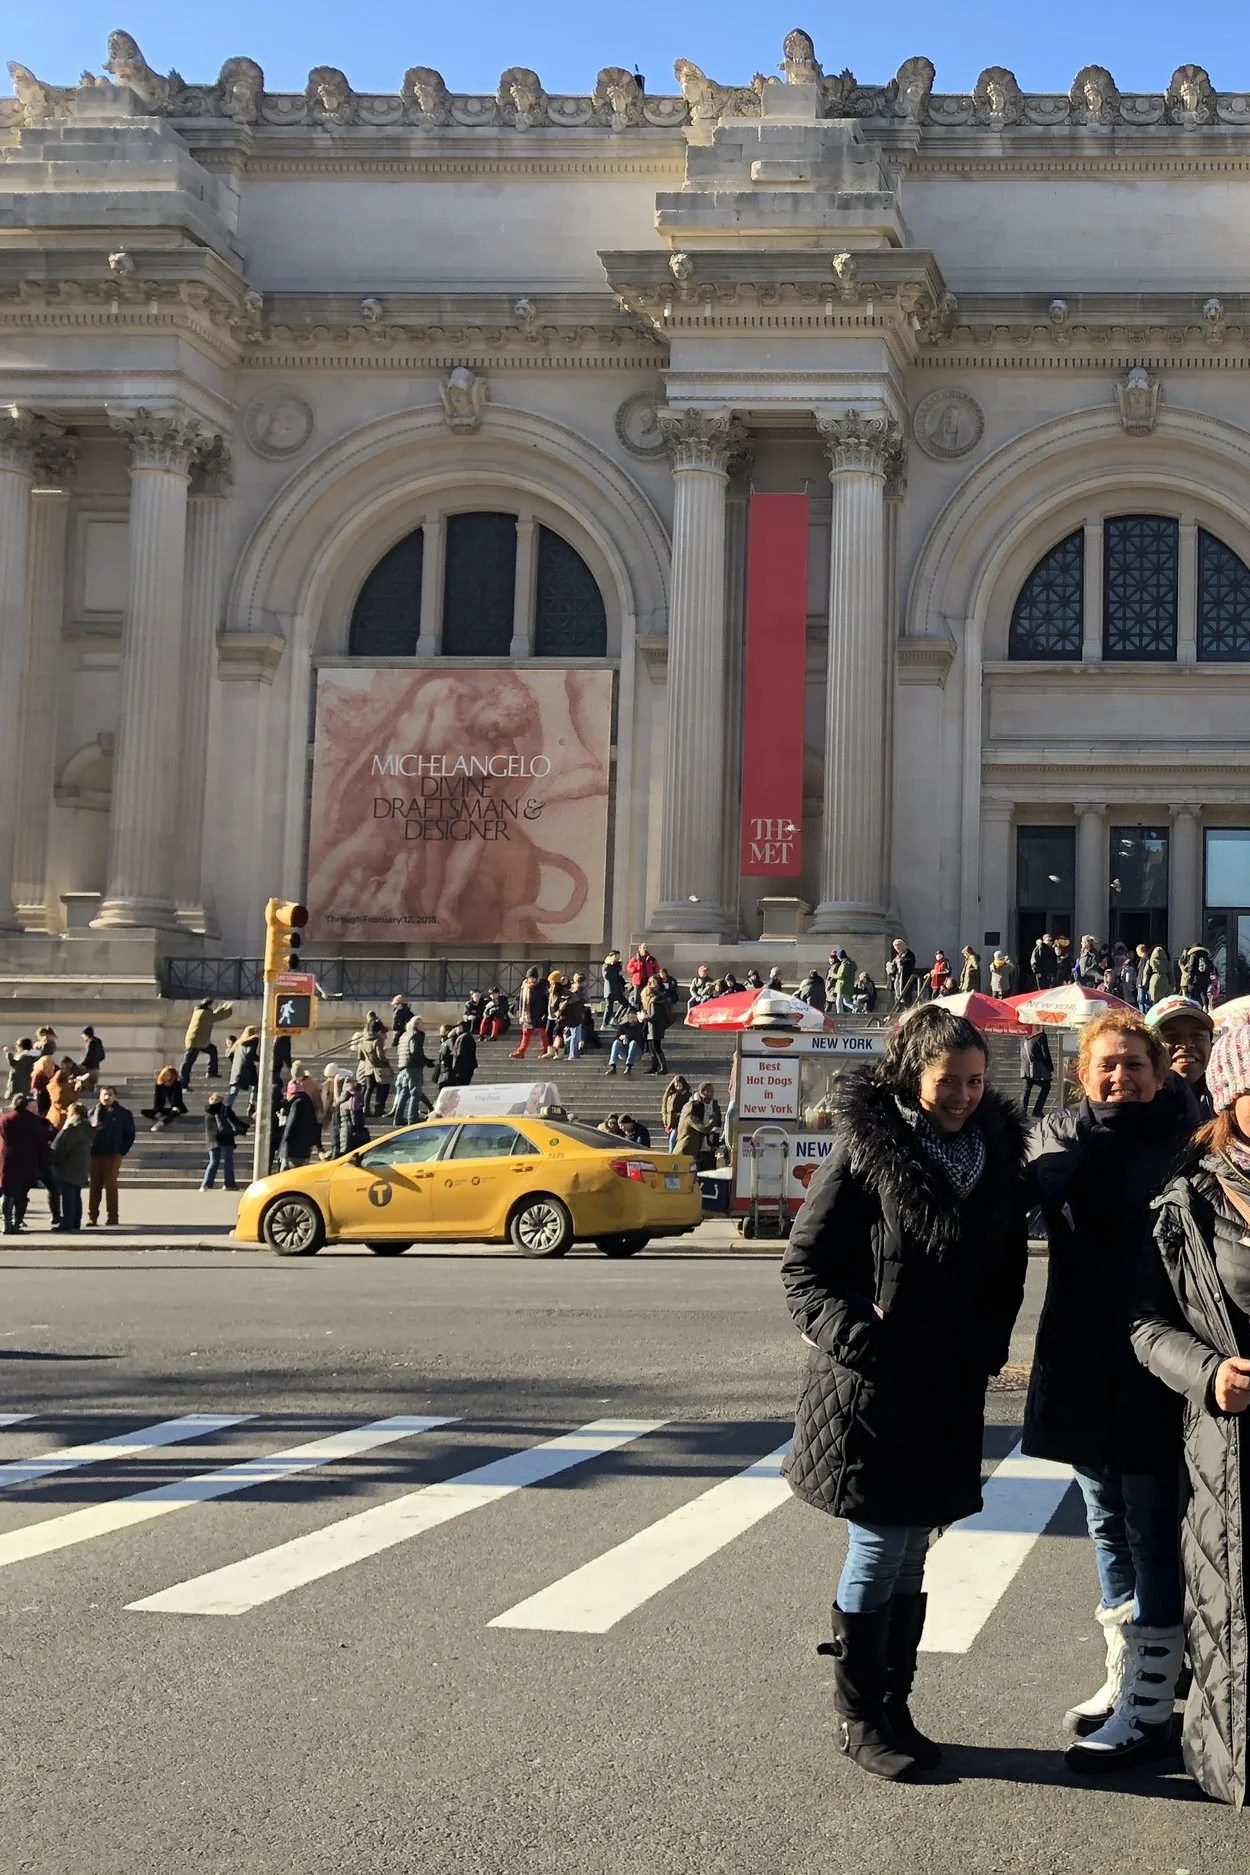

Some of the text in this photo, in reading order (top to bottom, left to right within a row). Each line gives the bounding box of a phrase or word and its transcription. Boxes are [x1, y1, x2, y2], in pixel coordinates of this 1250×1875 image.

[370, 754, 551, 778] MICHELANGELO
[420, 776, 491, 798] DIVINE
[372, 798, 546, 820] DRAFTSMAN &
[403, 819, 511, 841] DESIGNER
[750, 818, 794, 841] THE
[749, 842, 794, 864] MET
[1055, 1003, 1077, 1011] YOR
[811, 1037, 873, 1050] NEW YORK
[759, 1062, 780, 1071] Best
[746, 1075, 793, 1087] Hot Dogs
[764, 1089, 774, 1099] in
[743, 1104, 793, 1114] New York
[795, 1141, 833, 1158] NEW
[372, 1184, 388, 1205] T
